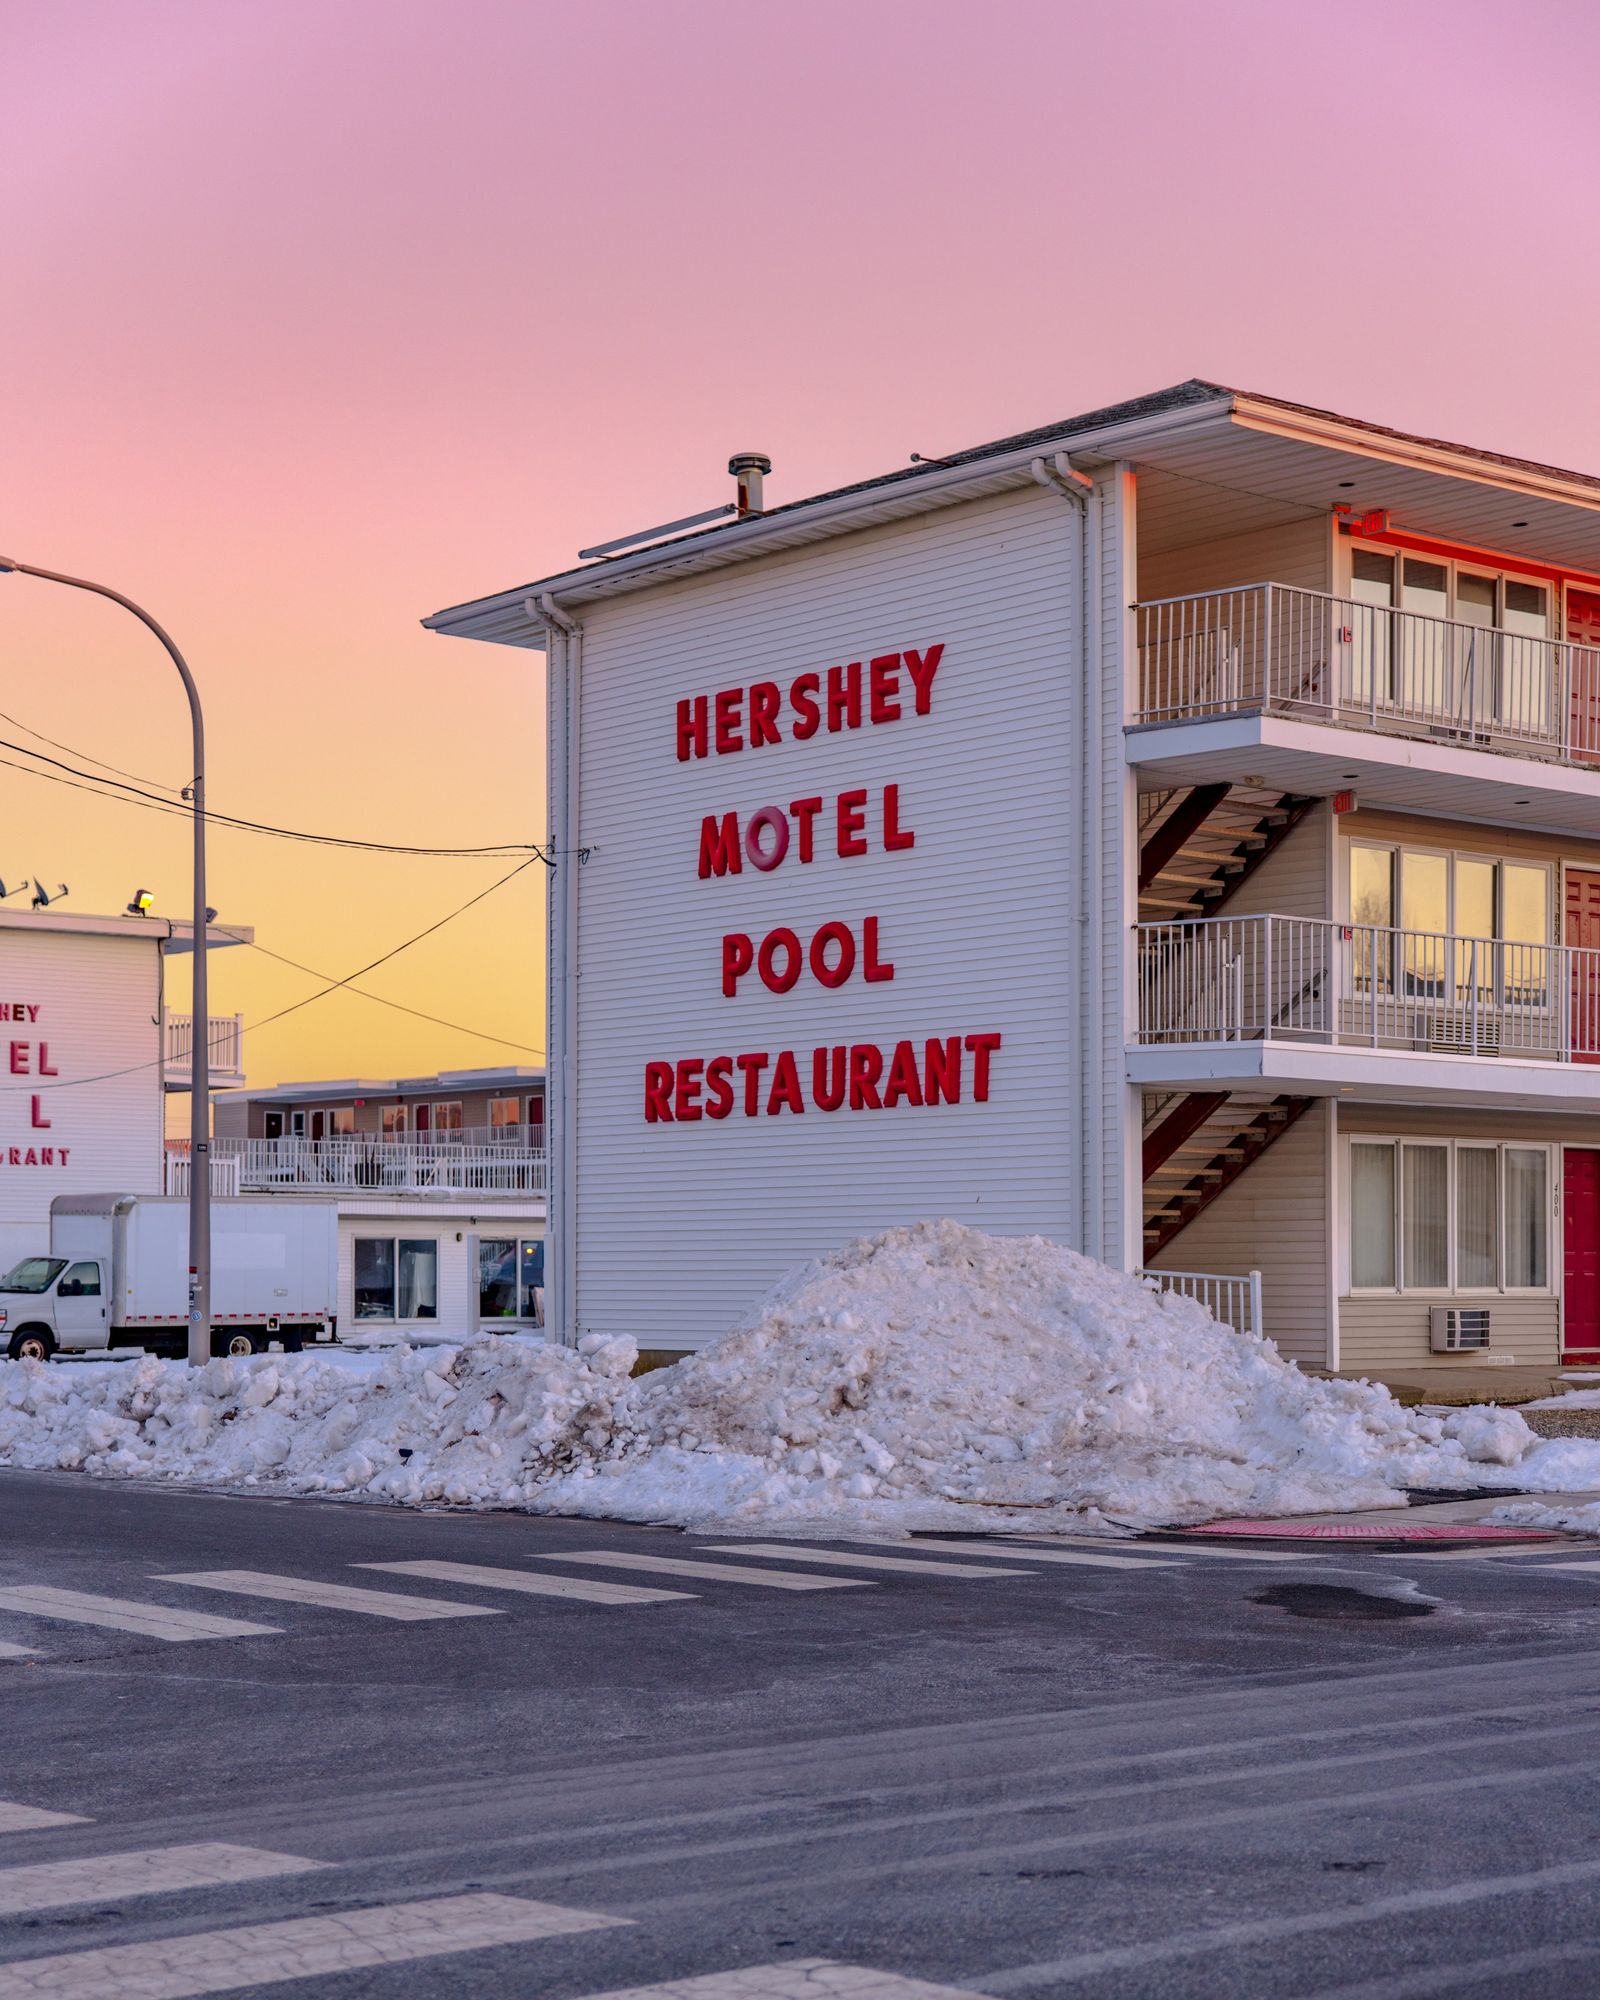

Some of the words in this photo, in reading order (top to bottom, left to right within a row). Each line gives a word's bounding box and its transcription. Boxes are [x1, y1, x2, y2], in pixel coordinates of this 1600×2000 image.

[677, 644, 944, 760] HERSHEY
[698, 784, 915, 879] MOTEL
[722, 916, 895, 997] POOL
[10, 1040, 58, 1076] EL
[645, 1033, 1001, 1123] RESTAURANT
[31, 1094, 51, 1129] L
[0, 1147, 70, 1166] RANT
